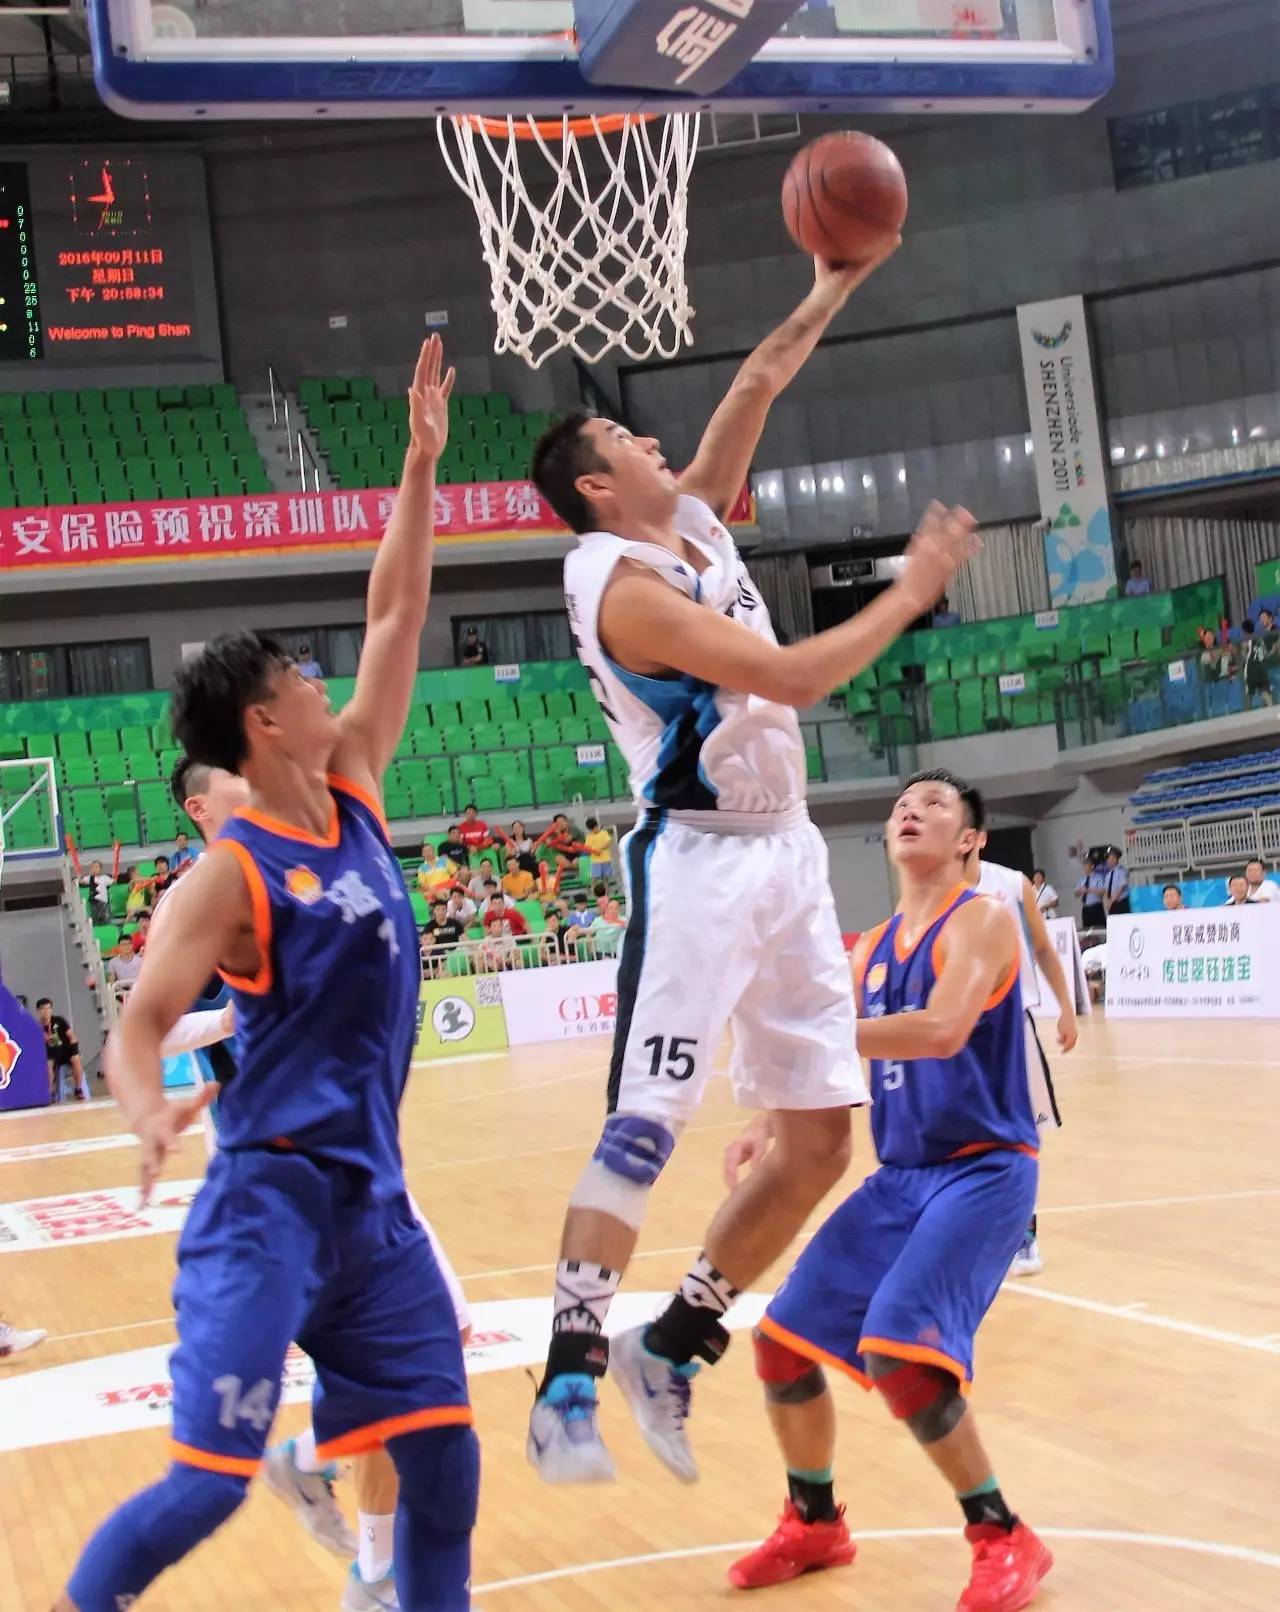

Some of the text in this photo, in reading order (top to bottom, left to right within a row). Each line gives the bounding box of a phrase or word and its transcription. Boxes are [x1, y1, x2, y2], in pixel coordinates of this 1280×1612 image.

[656, 0, 754, 85] 金
[58, 248, 163, 266] 2016年09月11日
[23, 270, 29, 280] 0
[92, 268, 135, 284] 星期日
[24, 283, 37, 294] 22
[66, 287, 96, 303] 下午
[48, 322, 190, 342] Welcome to Ping Shan
[1060, 355, 1081, 445] Universiade
[1040, 360, 1070, 492] SHENZHEN 2011
[644, 1035, 698, 1081] 15
[213, 1374, 275, 1430] 14
